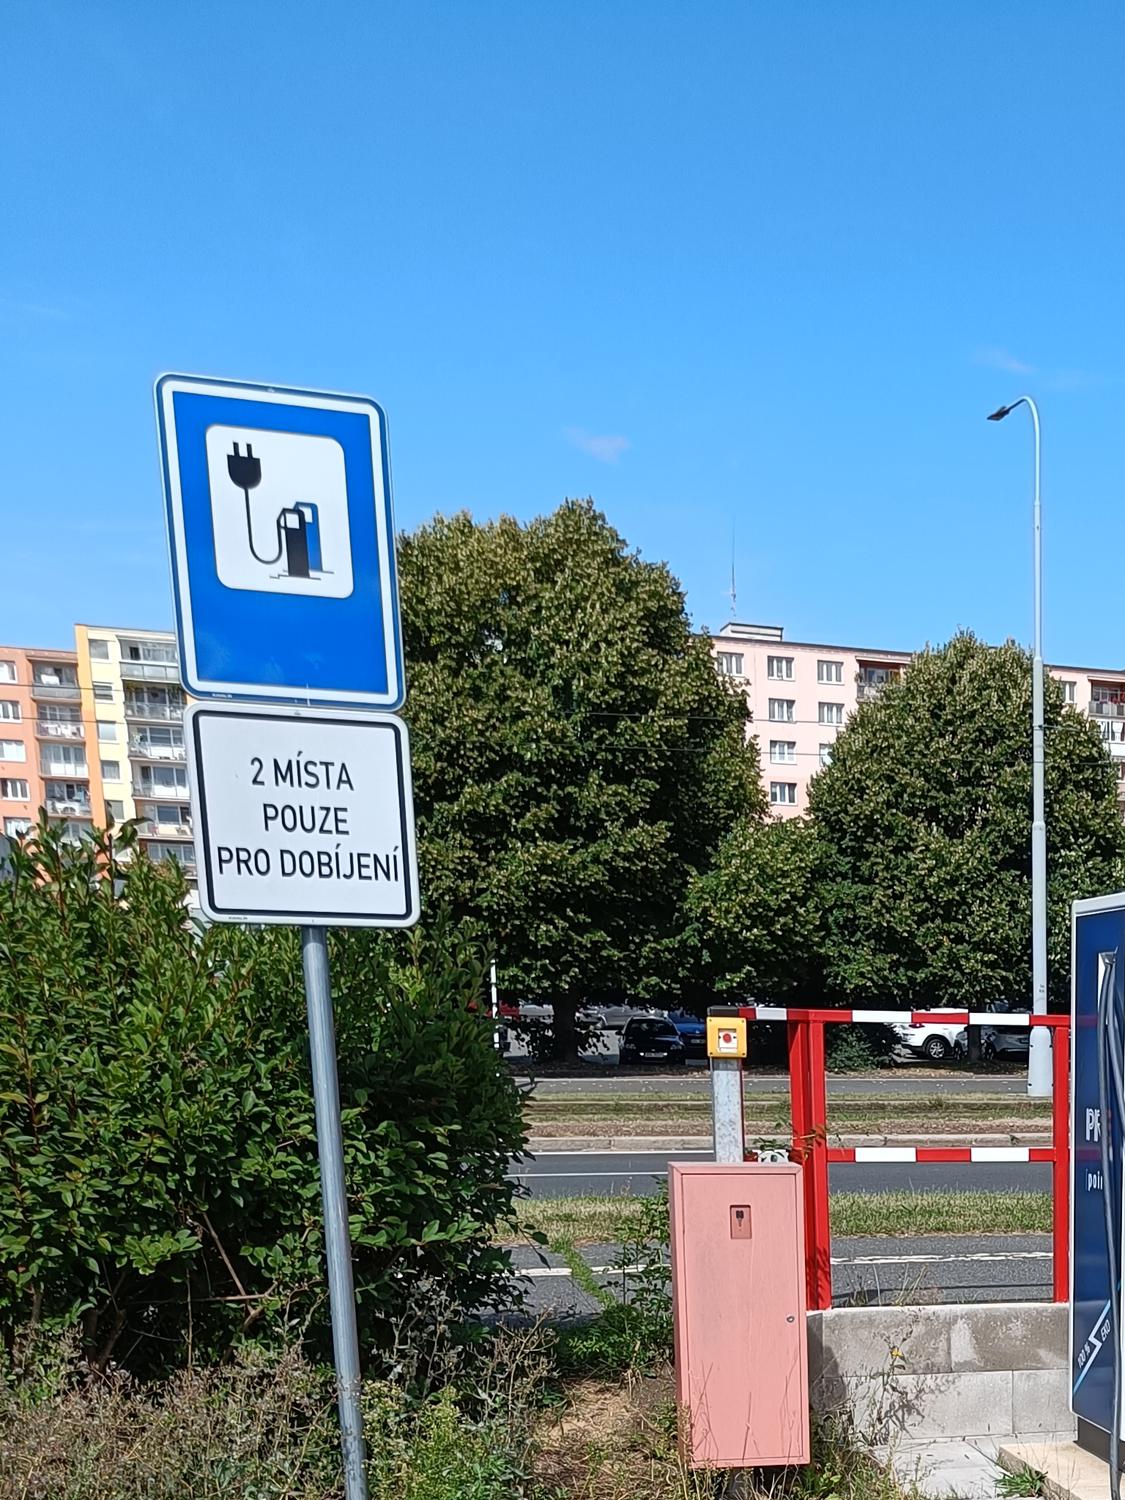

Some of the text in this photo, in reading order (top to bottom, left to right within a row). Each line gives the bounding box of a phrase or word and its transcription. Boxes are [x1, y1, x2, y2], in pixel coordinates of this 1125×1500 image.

[251, 751, 354, 791] 2 MÍSTA
[263, 803, 350, 836] POUZE
[217, 843, 399, 882] PRO DOBÍJENÍ
